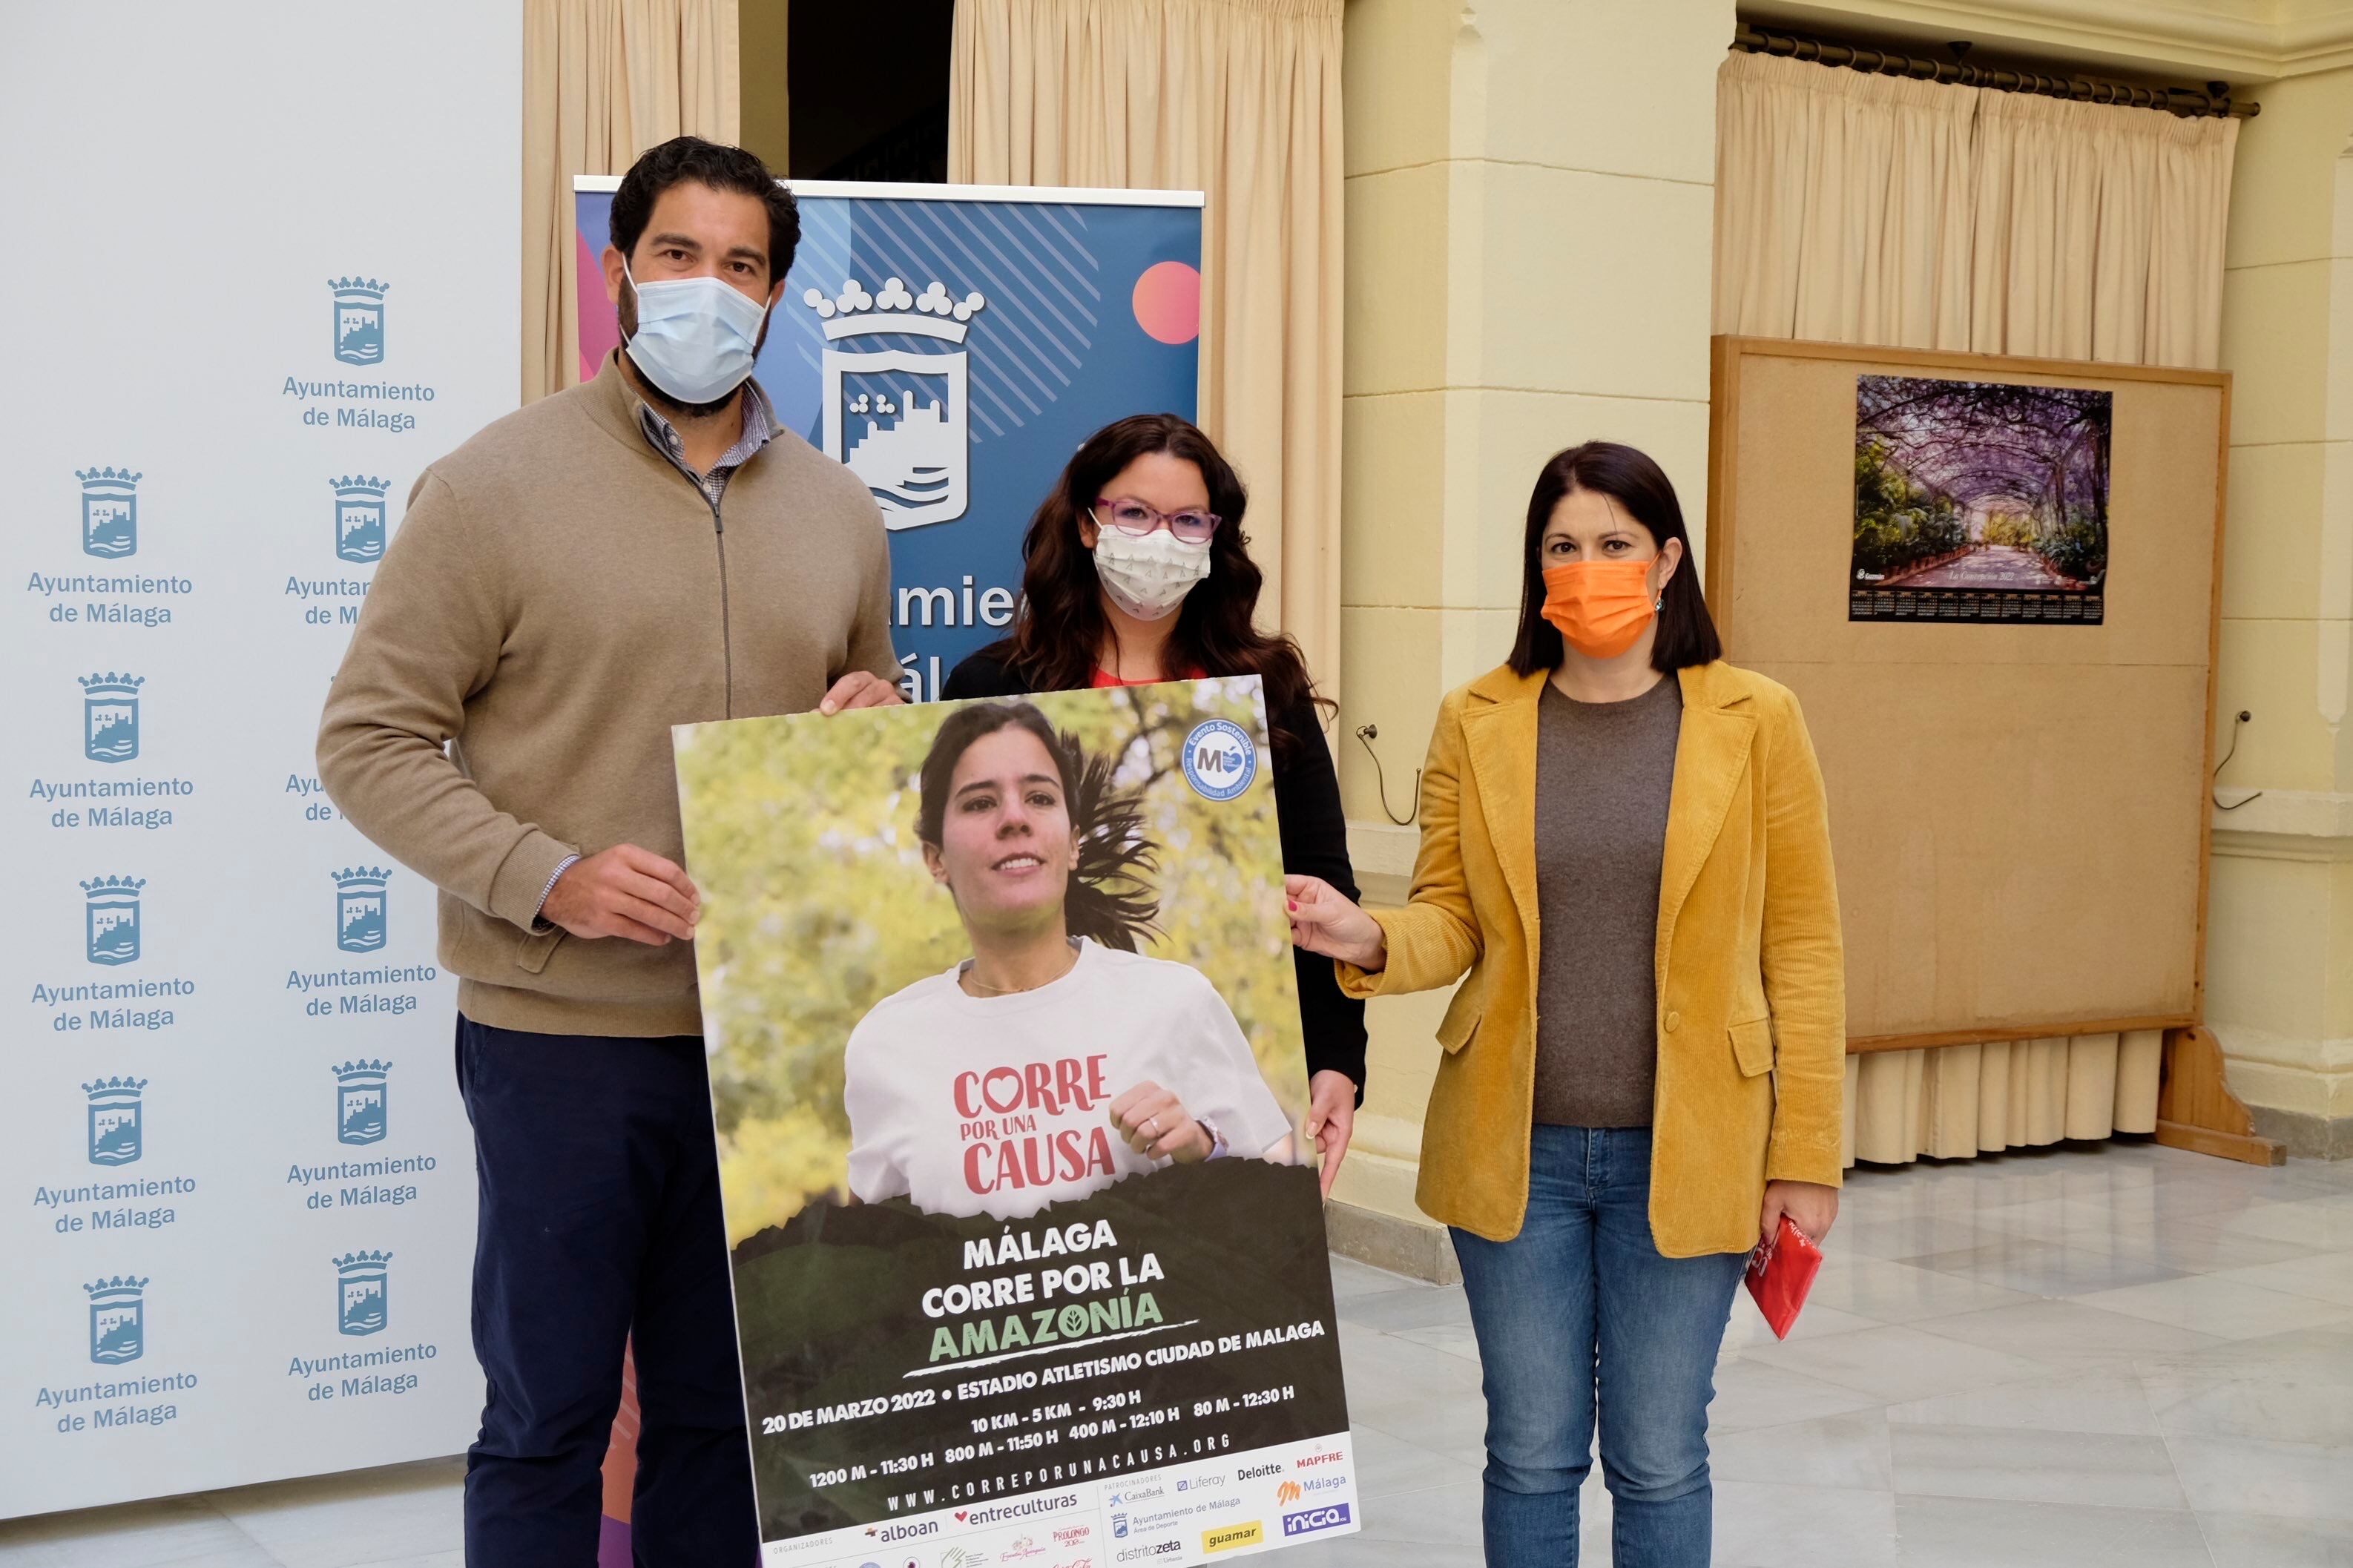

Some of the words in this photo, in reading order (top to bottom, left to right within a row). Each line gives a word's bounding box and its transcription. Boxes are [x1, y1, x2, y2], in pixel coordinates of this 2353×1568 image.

[283, 376, 435, 401] Ayuntamiento
[303, 409, 329, 426] de
[338, 408, 415, 432] Málaga
[28, 572, 193, 596] Ayuntamiento
[50, 604, 77, 622] de
[87, 603, 171, 627] Málaga
[305, 606, 332, 624] de
[1188, 724, 1216, 746] Evento
[1217, 722, 1251, 755] Sostenible
[30, 779, 193, 803] Ayuntamiento
[51, 810, 79, 828] de
[88, 806, 173, 829] Málaga
[306, 803, 332, 820] de
[286, 965, 436, 991] Ayuntamiento
[32, 978, 194, 1007] Ayuntamiento
[306, 998, 332, 1016] de
[340, 995, 417, 1016] Málaga
[53, 1012, 81, 1031] de
[90, 1009, 174, 1030] Málaga
[953, 1053, 1111, 1119] CORRE
[960, 1119, 1000, 1141] POR
[1002, 1115, 1037, 1136] UNA
[288, 1155, 436, 1186] Ayuntamiento
[964, 1126, 1116, 1195] CAUSA
[33, 1176, 196, 1207] Ayuntamiento
[306, 1191, 332, 1209] de
[340, 1185, 417, 1207] Málaga
[55, 1214, 83, 1233] de
[91, 1206, 176, 1229] Málaga
[964, 1219, 1118, 1270] MÁLAGA
[922, 1274, 1034, 1317] CORRE
[1041, 1262, 1112, 1298] POR
[1119, 1253, 1165, 1285] LA
[929, 1288, 1164, 1362] AMAZONÍA
[289, 1344, 437, 1377] Ayuntamiento
[308, 1383, 334, 1401] de
[341, 1374, 418, 1395] Málaga
[763, 1414, 787, 1434] 20
[789, 1410, 814, 1429] DE
[817, 1397, 889, 1424] MARZO
[891, 1389, 935, 1411] 2022
[957, 1371, 1038, 1400] ESTADIO
[1041, 1353, 1142, 1385] ATLETISMO
[1145, 1340, 1214, 1366] CIUDAD
[1218, 1334, 1241, 1354] DE
[1245, 1320, 1326, 1348] MALAGA
[36, 1372, 198, 1408] Ayuntamiento
[57, 1414, 86, 1433] de
[93, 1404, 177, 1428] Málaga
[971, 1417, 988, 1433] 10
[991, 1413, 1018, 1430] KM
[1032, 1408, 1042, 1423] 5
[1044, 1403, 1071, 1420] KM
[1093, 1393, 1125, 1411] 9:30
[1128, 1390, 1141, 1404] H
[809, 1469, 847, 1488] 1200
[852, 1465, 867, 1480] M
[881, 1456, 918, 1475] 11:30
[921, 1452, 934, 1467] H
[944, 1445, 975, 1463] 800
[978, 1441, 994, 1457] M
[1007, 1432, 1043, 1452] 11:50
[1046, 1429, 1059, 1444] H
[1069, 1422, 1098, 1440] 400
[1102, 1419, 1117, 1434] M
[1130, 1410, 1165, 1429] 12:10
[1168, 1406, 1179, 1421] H
[1194, 1401, 1213, 1417] 80
[1216, 1398, 1230, 1412] M
[1243, 1389, 1280, 1408] 12:30
[1282, 1386, 1294, 1400] H
[888, 1434, 1230, 1511] WWW.CORREPORUNACAUSA.ORG
[1297, 1452, 1343, 1468] MAPFRE
[1105, 1475, 1162, 1490] PATROCINADORES
[1125, 1486, 1164, 1501] CaixaBank
[1190, 1475, 1225, 1489] Liferay
[1303, 1476, 1346, 1491] Málaga
[970, 1492, 1078, 1526] entreculturas
[1133, 1507, 1194, 1526] Ayuntamiento
[1196, 1503, 1206, 1512] de
[1209, 1498, 1240, 1509] Málaga
[881, 1519, 938, 1544] alboan
[1053, 1526, 1090, 1542] PROLONGO
[1156, 1521, 1178, 1531] Deporte
[1209, 1528, 1257, 1547] guamar
[774, 1538, 832, 1554] ORGANIZADORES
[1116, 1540, 1181, 1563] distritozeta
